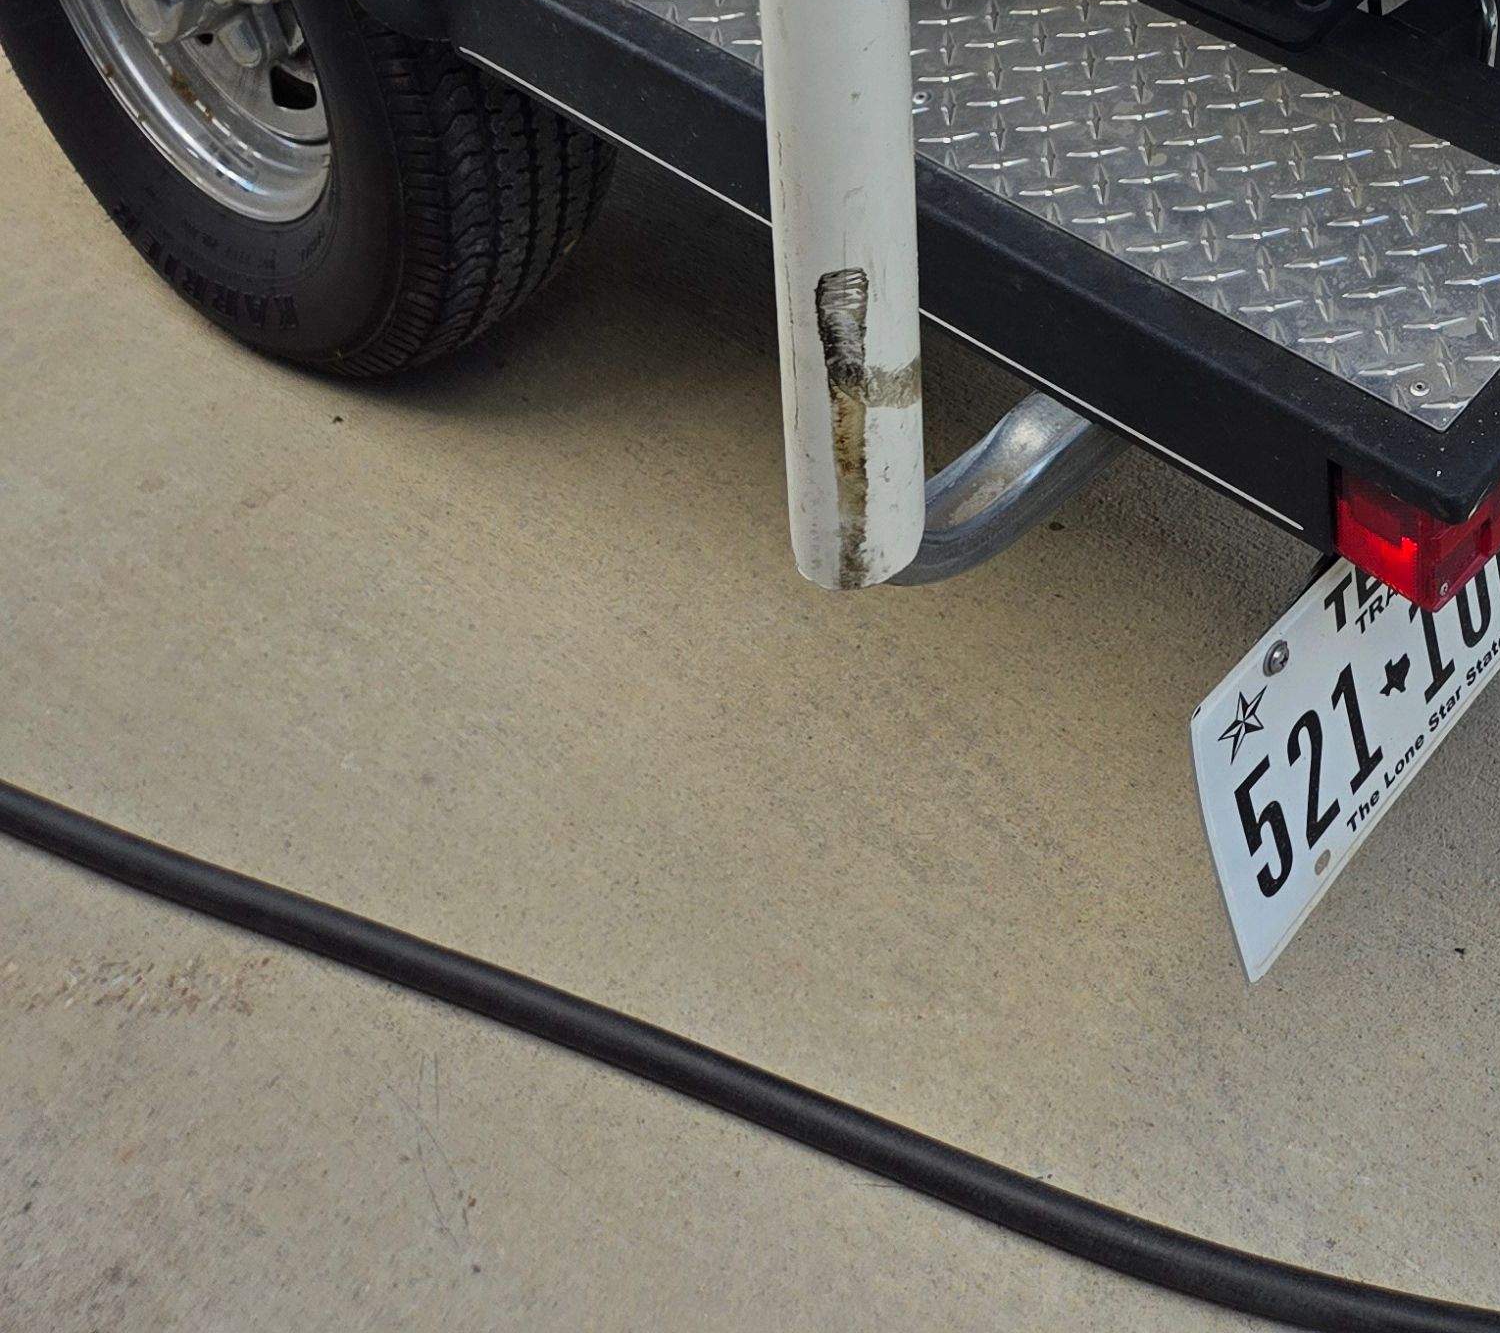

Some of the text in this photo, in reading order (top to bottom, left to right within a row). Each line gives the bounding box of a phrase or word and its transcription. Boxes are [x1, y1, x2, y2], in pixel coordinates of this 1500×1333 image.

[1233, 663, 1385, 898] 521
[1346, 787, 1382, 833] The
[1384, 730, 1425, 790] Lone
[1428, 685, 1463, 735] Star
